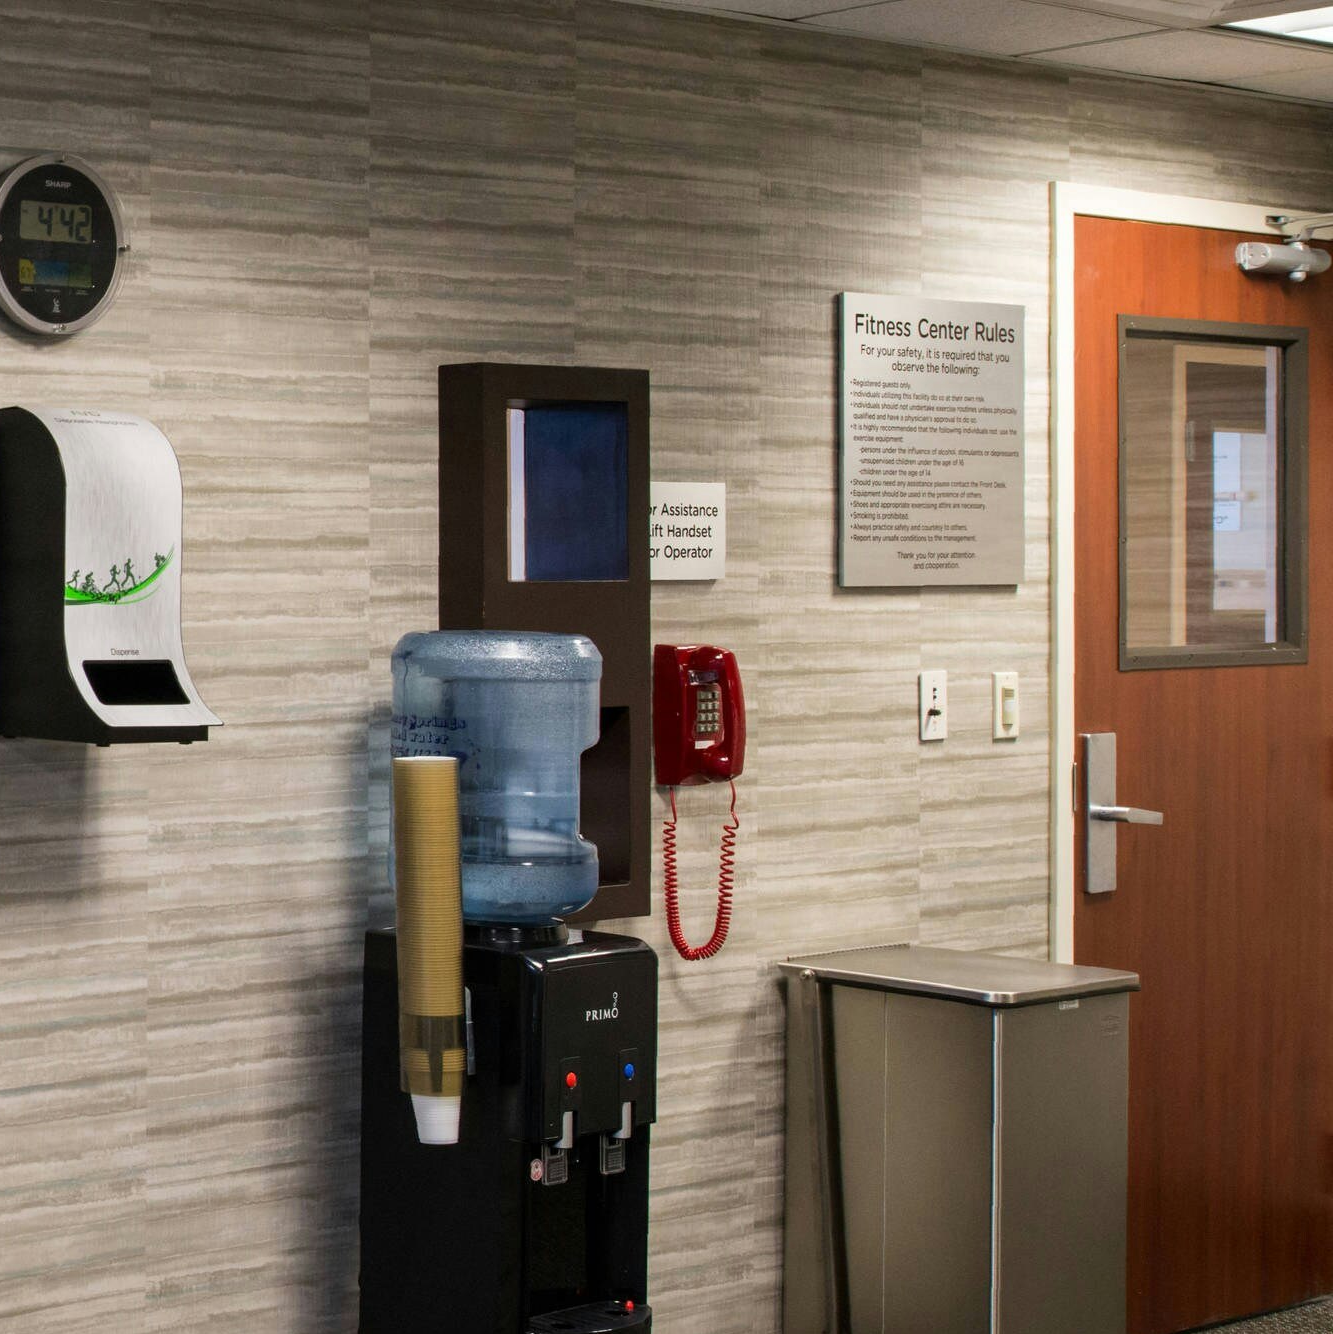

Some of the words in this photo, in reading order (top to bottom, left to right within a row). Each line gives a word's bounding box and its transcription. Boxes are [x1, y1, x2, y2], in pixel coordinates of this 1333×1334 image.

[45, 180, 71, 189] SHARP
[855, 313, 911, 337] Fitness
[918, 318, 969, 341] Center
[975, 322, 1015, 344] Rules
[860, 344, 874, 355] For
[877, 347, 896, 357] your
[897, 348, 925, 361] safety,
[926, 349, 932, 359] it
[934, 350, 940, 360] is
[942, 351, 976, 363] required
[978, 351, 993, 362] that
[995, 354, 1010, 364] you
[892, 361, 925, 372] observe
[927, 363, 939, 373] the
[941, 363, 980, 376] following:
[661, 503, 718, 517] Assistance
[648, 524, 663, 538] ift
[667, 524, 712, 538] Handset
[664, 545, 713, 560] Operator
[927, 551, 935, 559] for
[937, 552, 950, 560] your
[585, 1007, 619, 1021] PRIMO
